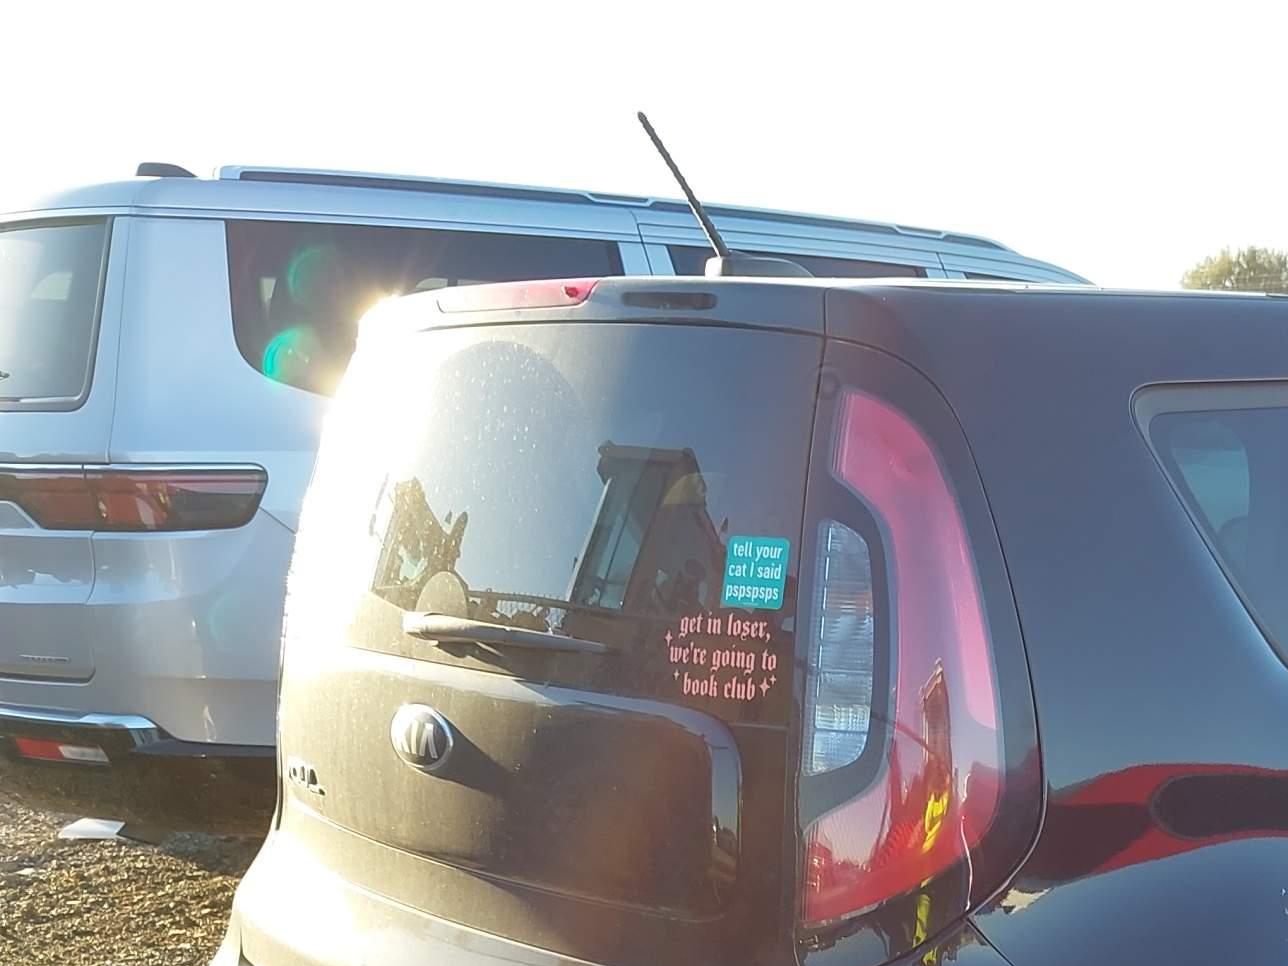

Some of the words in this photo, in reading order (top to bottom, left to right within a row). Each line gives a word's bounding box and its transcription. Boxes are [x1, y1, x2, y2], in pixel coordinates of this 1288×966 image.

[733, 541, 752, 557] tell
[755, 545, 783, 562] your
[728, 563, 746, 577] cat
[757, 563, 782, 580] said
[725, 584, 778, 603] pspspsps
[678, 615, 703, 639] get
[707, 611, 721, 635] in
[727, 612, 771, 643] loser,
[669, 642, 707, 665] we're
[711, 644, 756, 676] going
[761, 649, 777, 671] to
[682, 671, 718, 697] book
[723, 675, 756, 700] club
